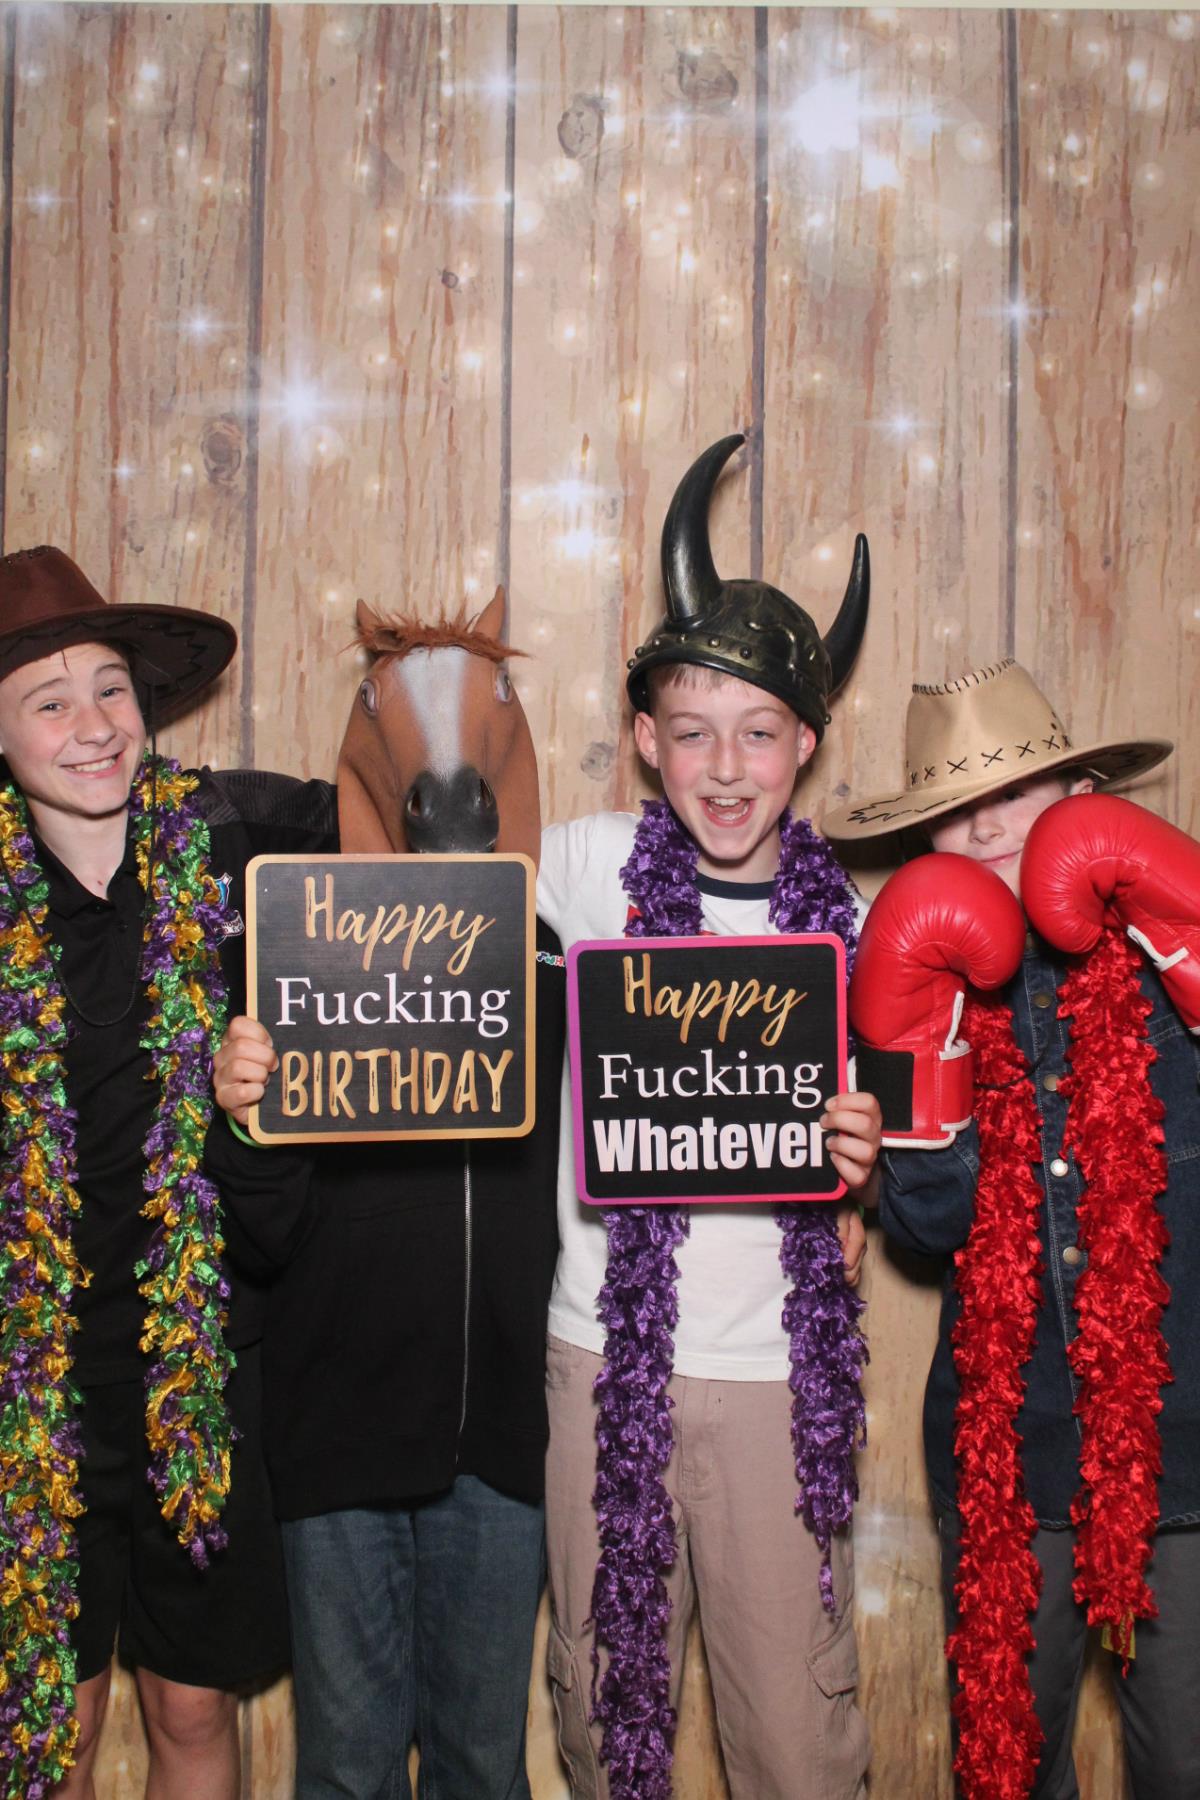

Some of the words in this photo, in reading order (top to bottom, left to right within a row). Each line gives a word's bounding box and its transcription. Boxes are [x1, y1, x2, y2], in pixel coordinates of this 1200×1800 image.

[304, 873, 496, 976] Happy
[275, 972, 511, 1038] Fucking
[622, 952, 808, 1046] Happy
[281, 1047, 514, 1119] BIRTHDAY
[598, 1048, 824, 1109] Fucking
[592, 1117, 828, 1173] Whatever
